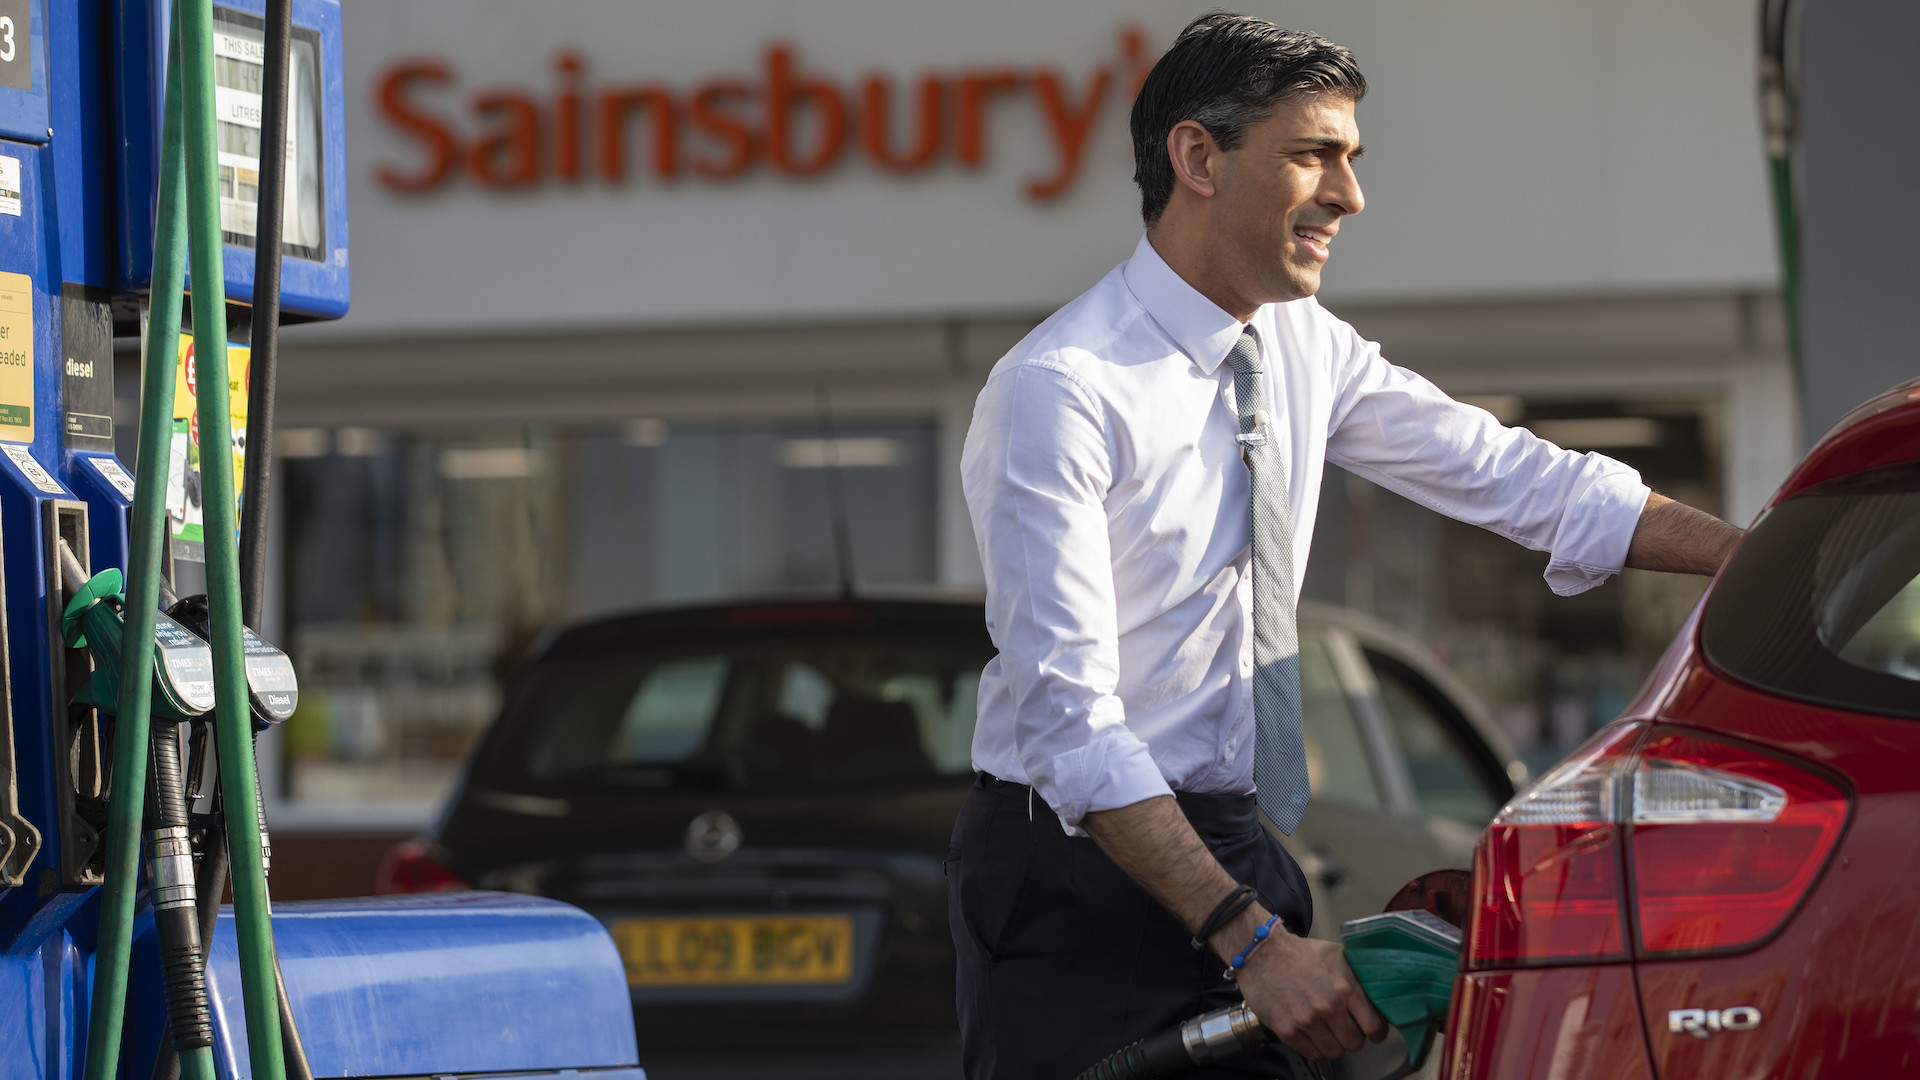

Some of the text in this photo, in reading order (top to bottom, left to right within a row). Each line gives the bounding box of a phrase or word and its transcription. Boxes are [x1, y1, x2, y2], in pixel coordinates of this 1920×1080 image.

[0, 15, 15, 62] 3
[223, 37, 243, 54] THIS
[231, 104, 260, 122] LITRES
[371, 27, 1151, 203] Sainsbury'
[0, 325, 10, 340] er
[0, 350, 26, 367] eaded
[65, 357, 94, 379] diesel
[268, 694, 291, 705] Diesel
[1668, 1006, 1762, 1039] RIO
